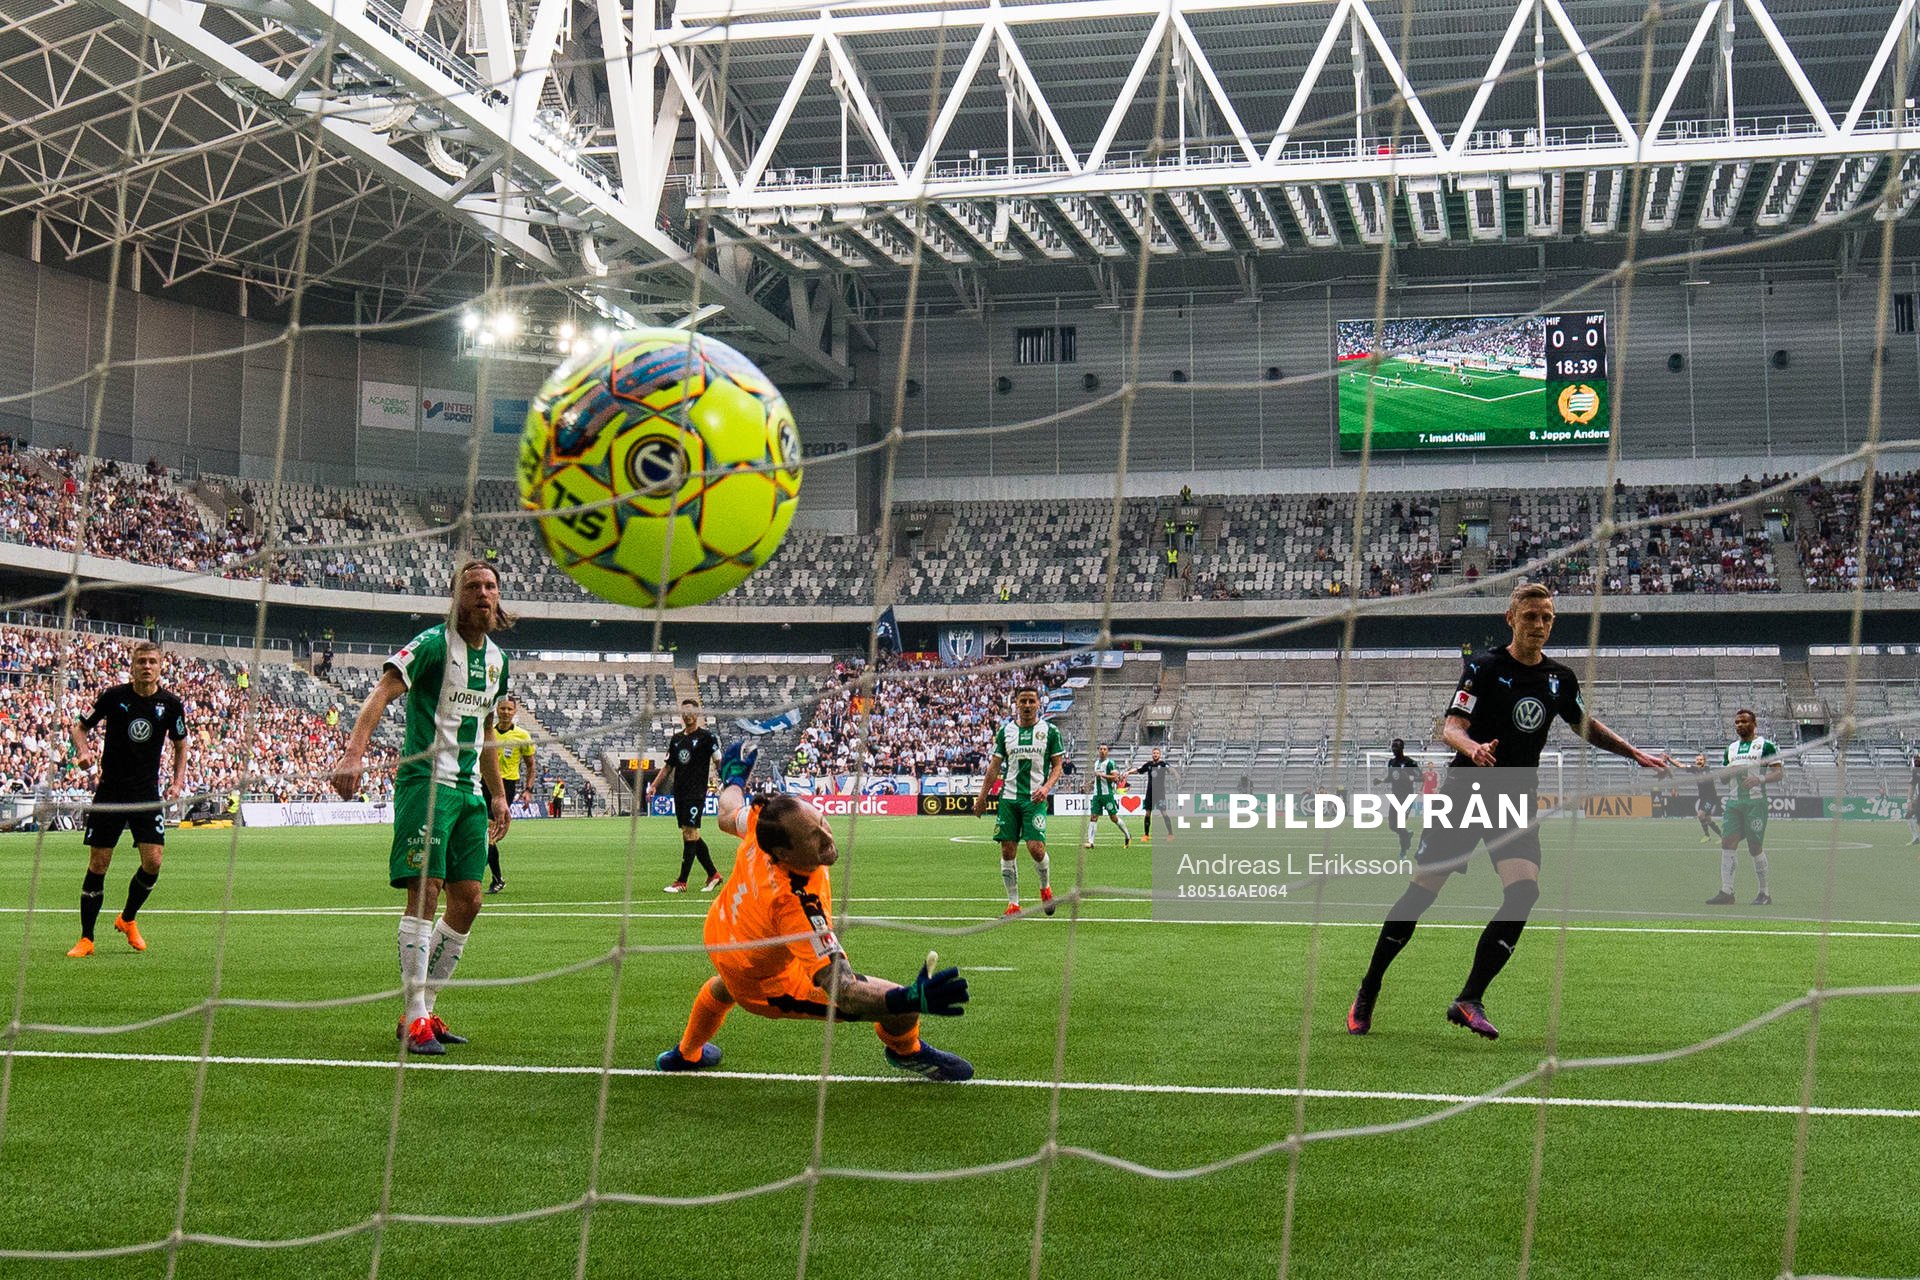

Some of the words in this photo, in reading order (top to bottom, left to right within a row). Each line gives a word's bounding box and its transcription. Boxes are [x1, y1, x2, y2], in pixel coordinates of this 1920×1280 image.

[1546, 317, 1560, 326] HIF
[1586, 316, 1604, 325] MFF
[1552, 331, 1564, 348] 0
[1586, 329, 1598, 347] 0
[1556, 359, 1598, 375] 18:39
[369, 396, 410, 407] ACADEMIC
[382, 405, 410, 415] WORK
[444, 402, 473, 414] INTER
[444, 412, 473, 423] SPORT
[1429, 433, 1453, 443] Imad
[1541, 431, 1571, 442] Jeppe
[803, 442, 849, 456] rena
[812, 797, 888, 814] Scandic
[945, 797, 967, 810] BC
[690, 806, 698, 820] 9
[407, 837, 441, 846] SAFEON
